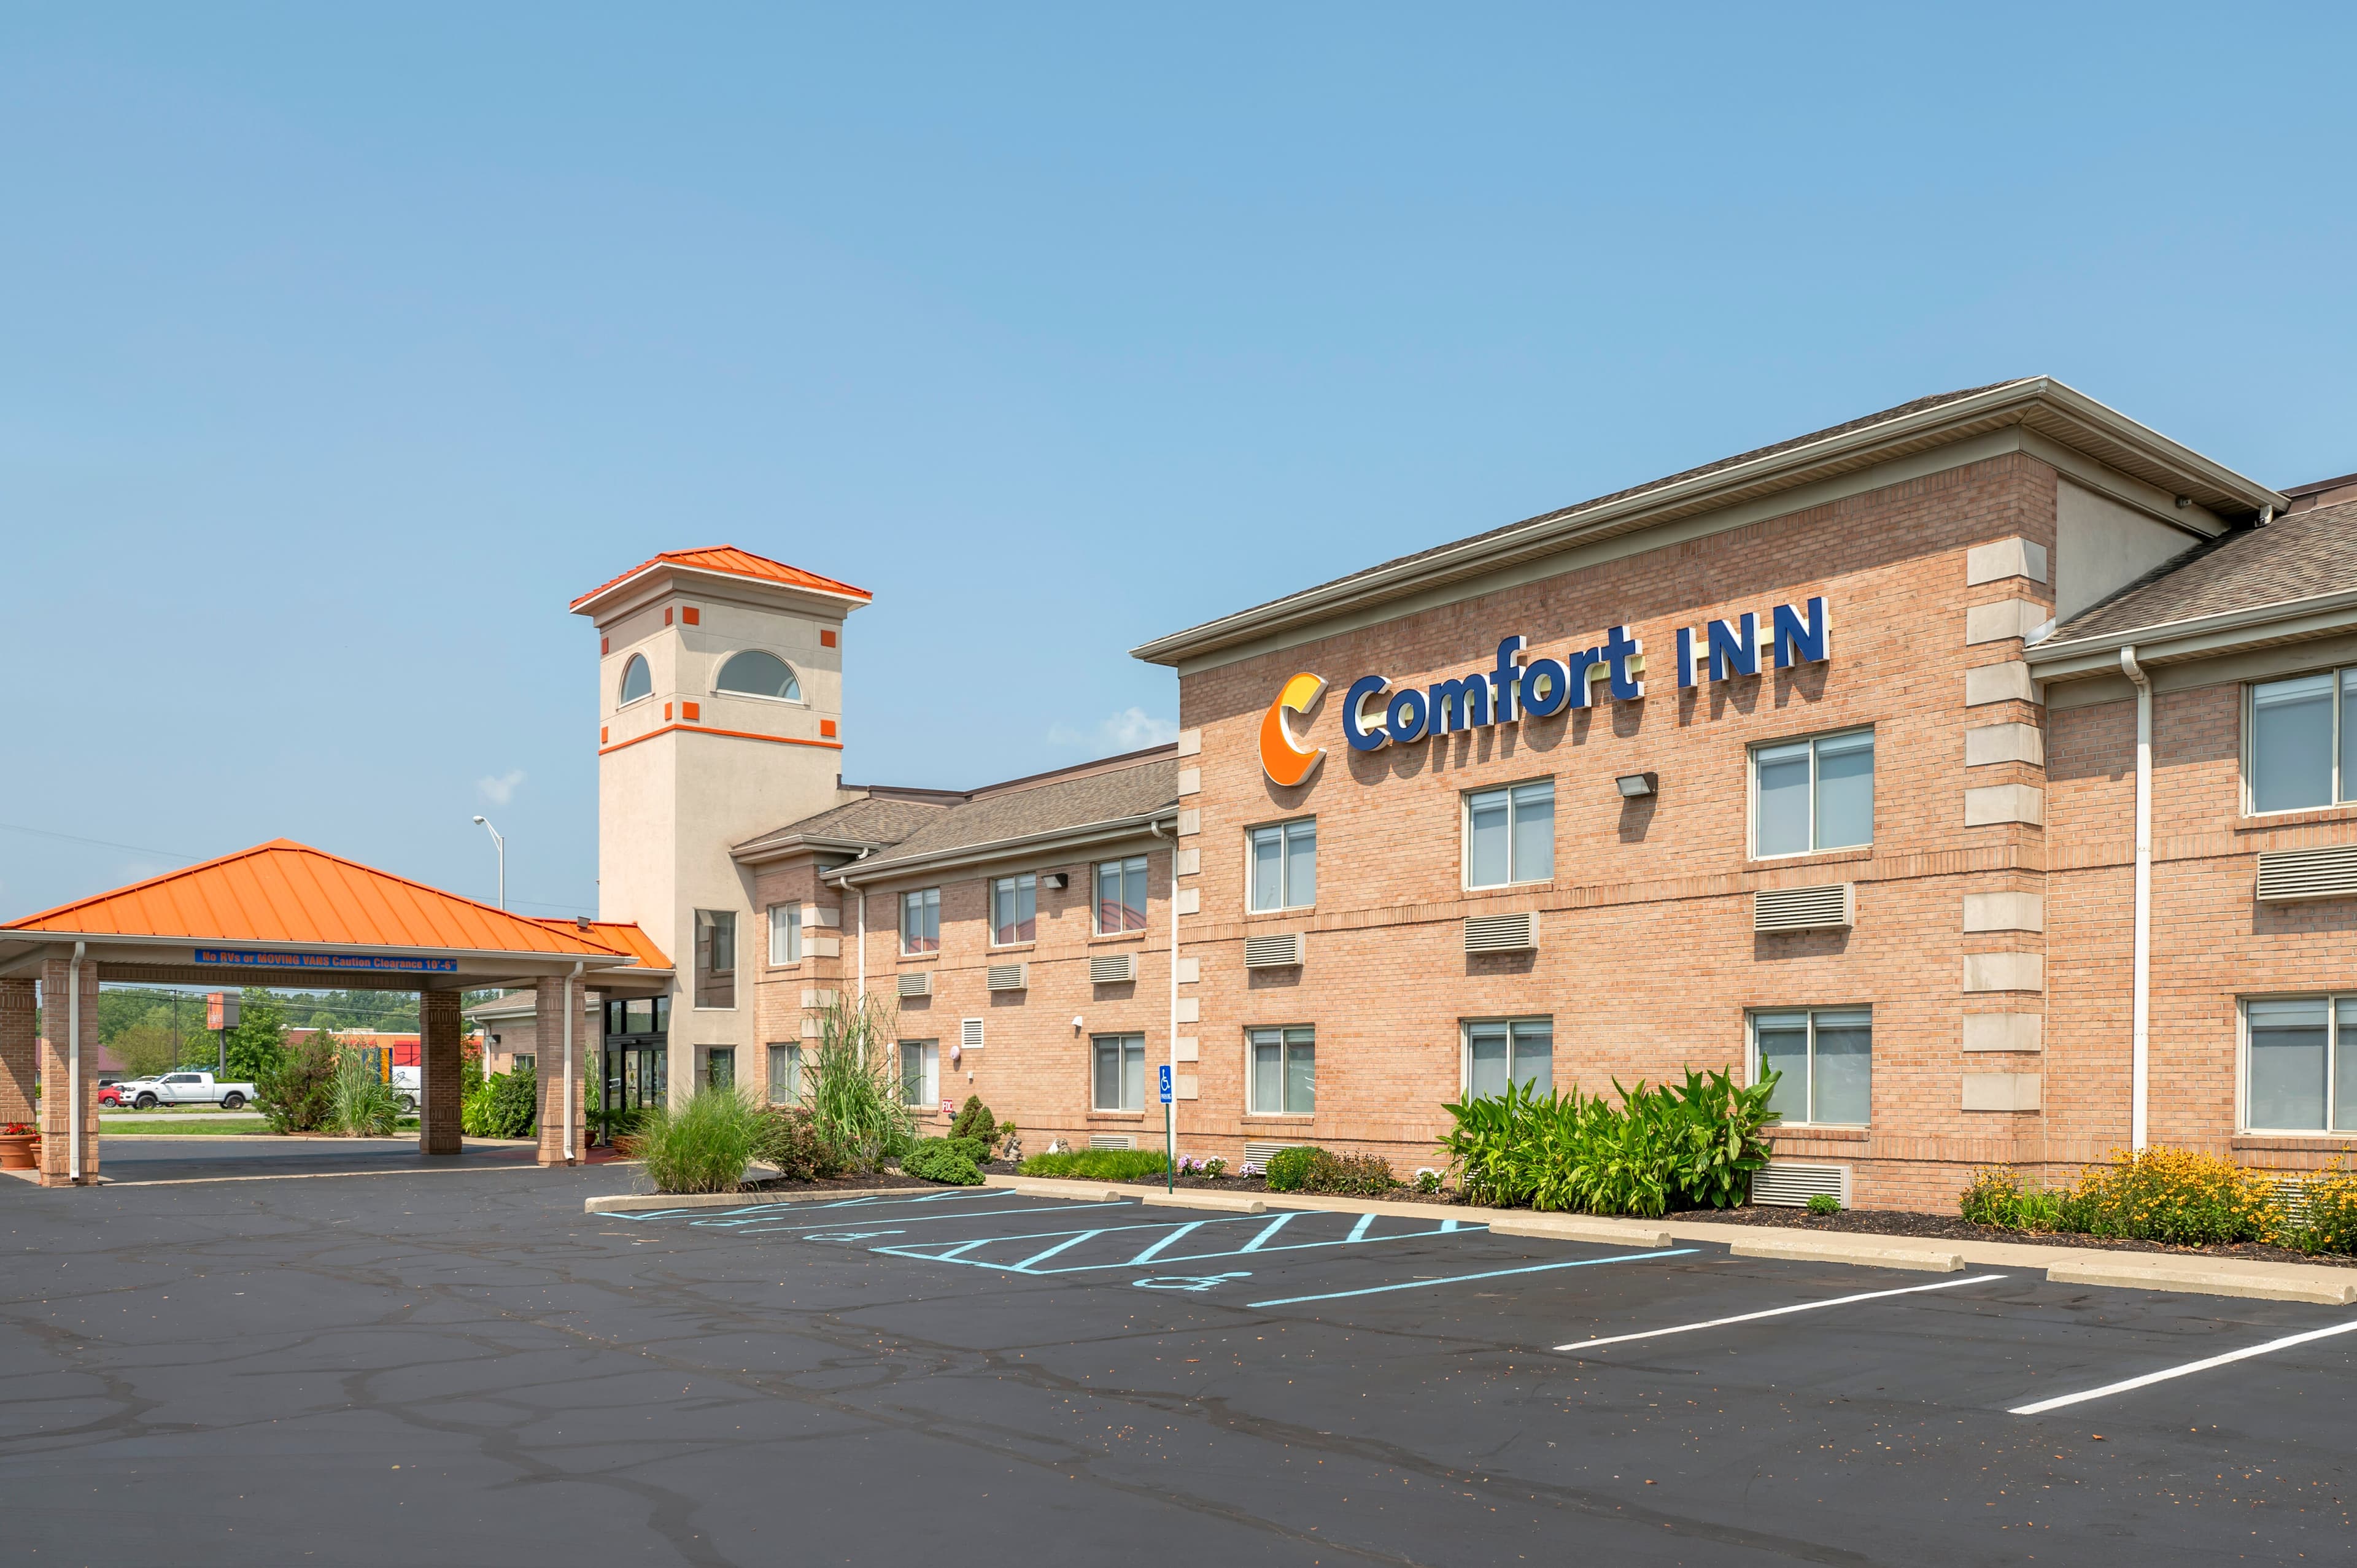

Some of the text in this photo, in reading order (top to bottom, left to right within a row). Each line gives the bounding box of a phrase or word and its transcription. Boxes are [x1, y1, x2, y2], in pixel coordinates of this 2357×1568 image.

[1343, 625, 1644, 751] Comfort
[1676, 597, 1829, 687] INN
[203, 951, 216, 961] No
[220, 952, 240, 962] RVs
[257, 953, 300, 964] MOVING
[303, 955, 329, 966] VANS
[332, 956, 371, 967] Caution
[374, 957, 422, 968] Clearance
[942, 1101, 953, 1111] FDC
